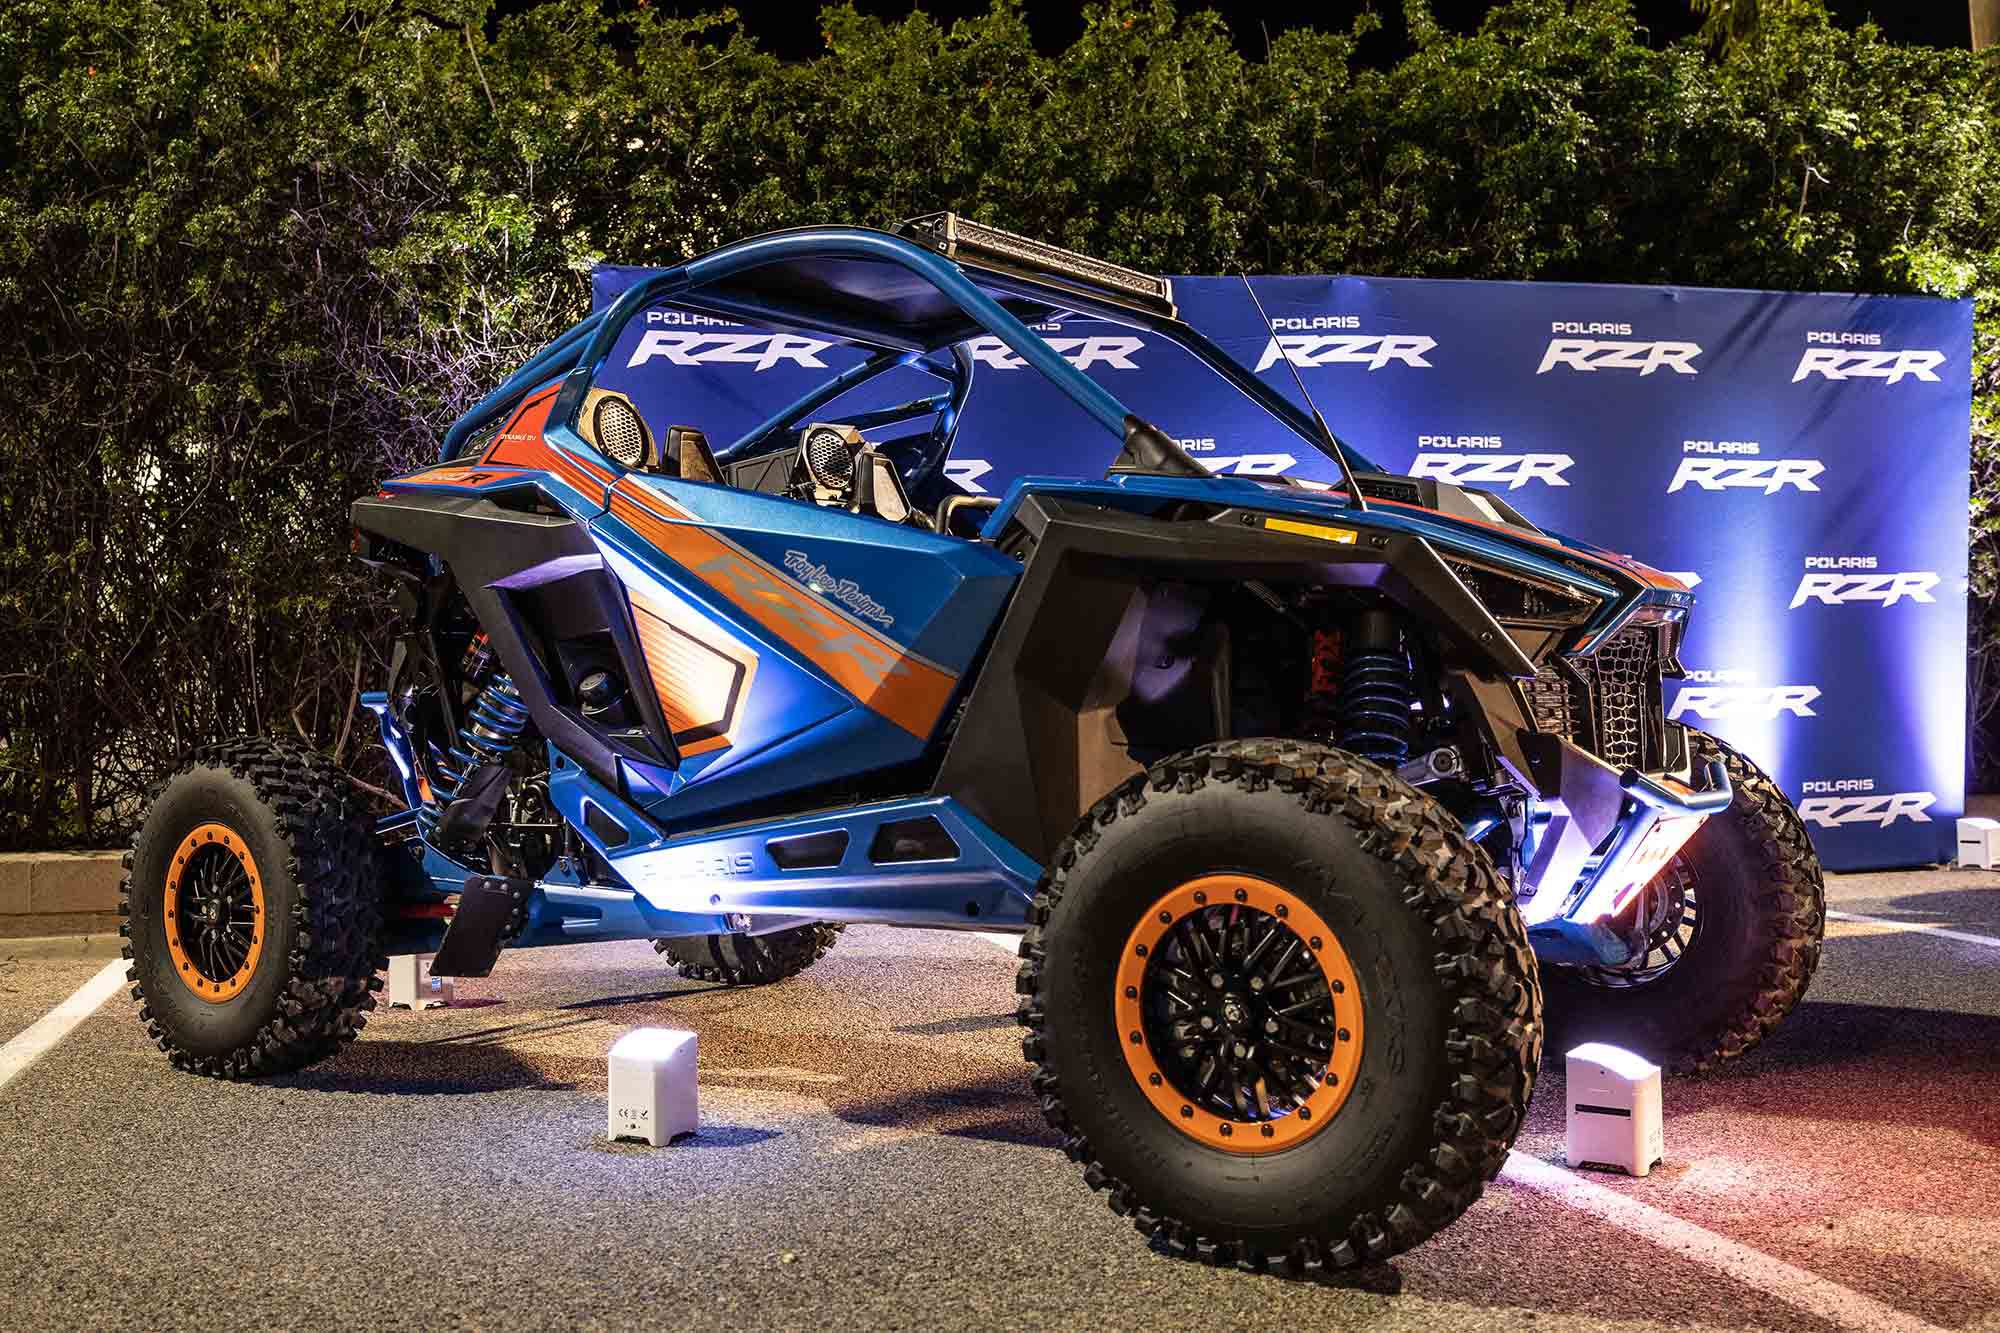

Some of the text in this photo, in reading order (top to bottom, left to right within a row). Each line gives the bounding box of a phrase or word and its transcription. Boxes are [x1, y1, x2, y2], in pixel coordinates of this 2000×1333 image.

[1272, 316, 1359, 330] POLARIS
[1552, 322, 1632, 335] POLARIS
[626, 329, 833, 371] RZR
[1807, 331, 1881, 345] POLARIS
[1254, 335, 1438, 372] RZR
[1536, 338, 1703, 376] RZR
[1792, 348, 1946, 384] RZR
[1174, 438, 1216, 451] ARIS
[1418, 435, 1502, 449] POLARIS
[1683, 440, 1760, 454] POLARIS
[1407, 453, 1575, 490] RZR
[1667, 457, 1826, 495] RZR
[1805, 556, 1878, 569] POLARIS
[1789, 571, 1941, 609] RZR
[1802, 778, 1874, 793] POLARIS
[1797, 791, 1937, 828] RZR
